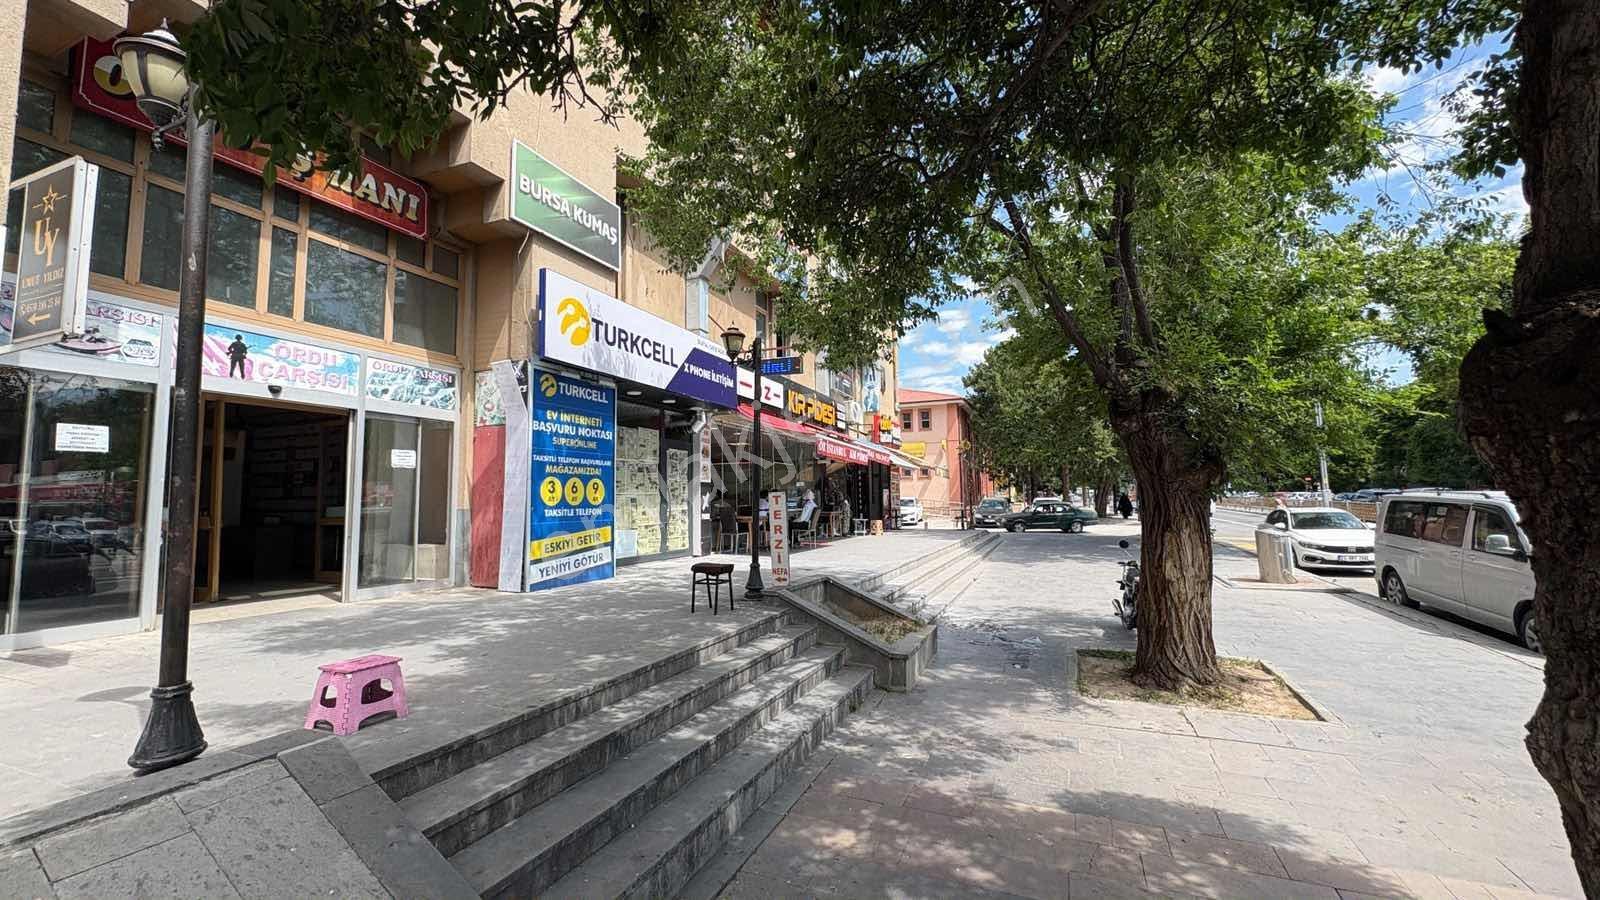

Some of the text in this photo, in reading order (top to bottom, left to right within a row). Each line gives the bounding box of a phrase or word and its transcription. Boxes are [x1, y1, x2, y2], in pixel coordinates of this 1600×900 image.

[519, 174, 618, 245] BURSA KUMAŞ
[273, 341, 337, 367] ORDU
[591, 318, 679, 369] TURKCELL
[684, 363, 735, 389] X PHONE İLETİŞİM
[558, 382, 608, 404] TURKCELL
[546, 409, 558, 420] EV
[788, 389, 806, 417] KIR
[807, 393, 836, 426] PİDESİ
[533, 420, 613, 441] BAŞVURU NOKTASI
[548, 480, 599, 494] 3 6 9
[544, 506, 602, 517] TAKSİTLE TELEFON
[544, 530, 601, 554] ESKİYİ GETİR
[539, 552, 604, 578] YENİYİ GÖTÜR
[772, 567, 788, 576] NEFA
